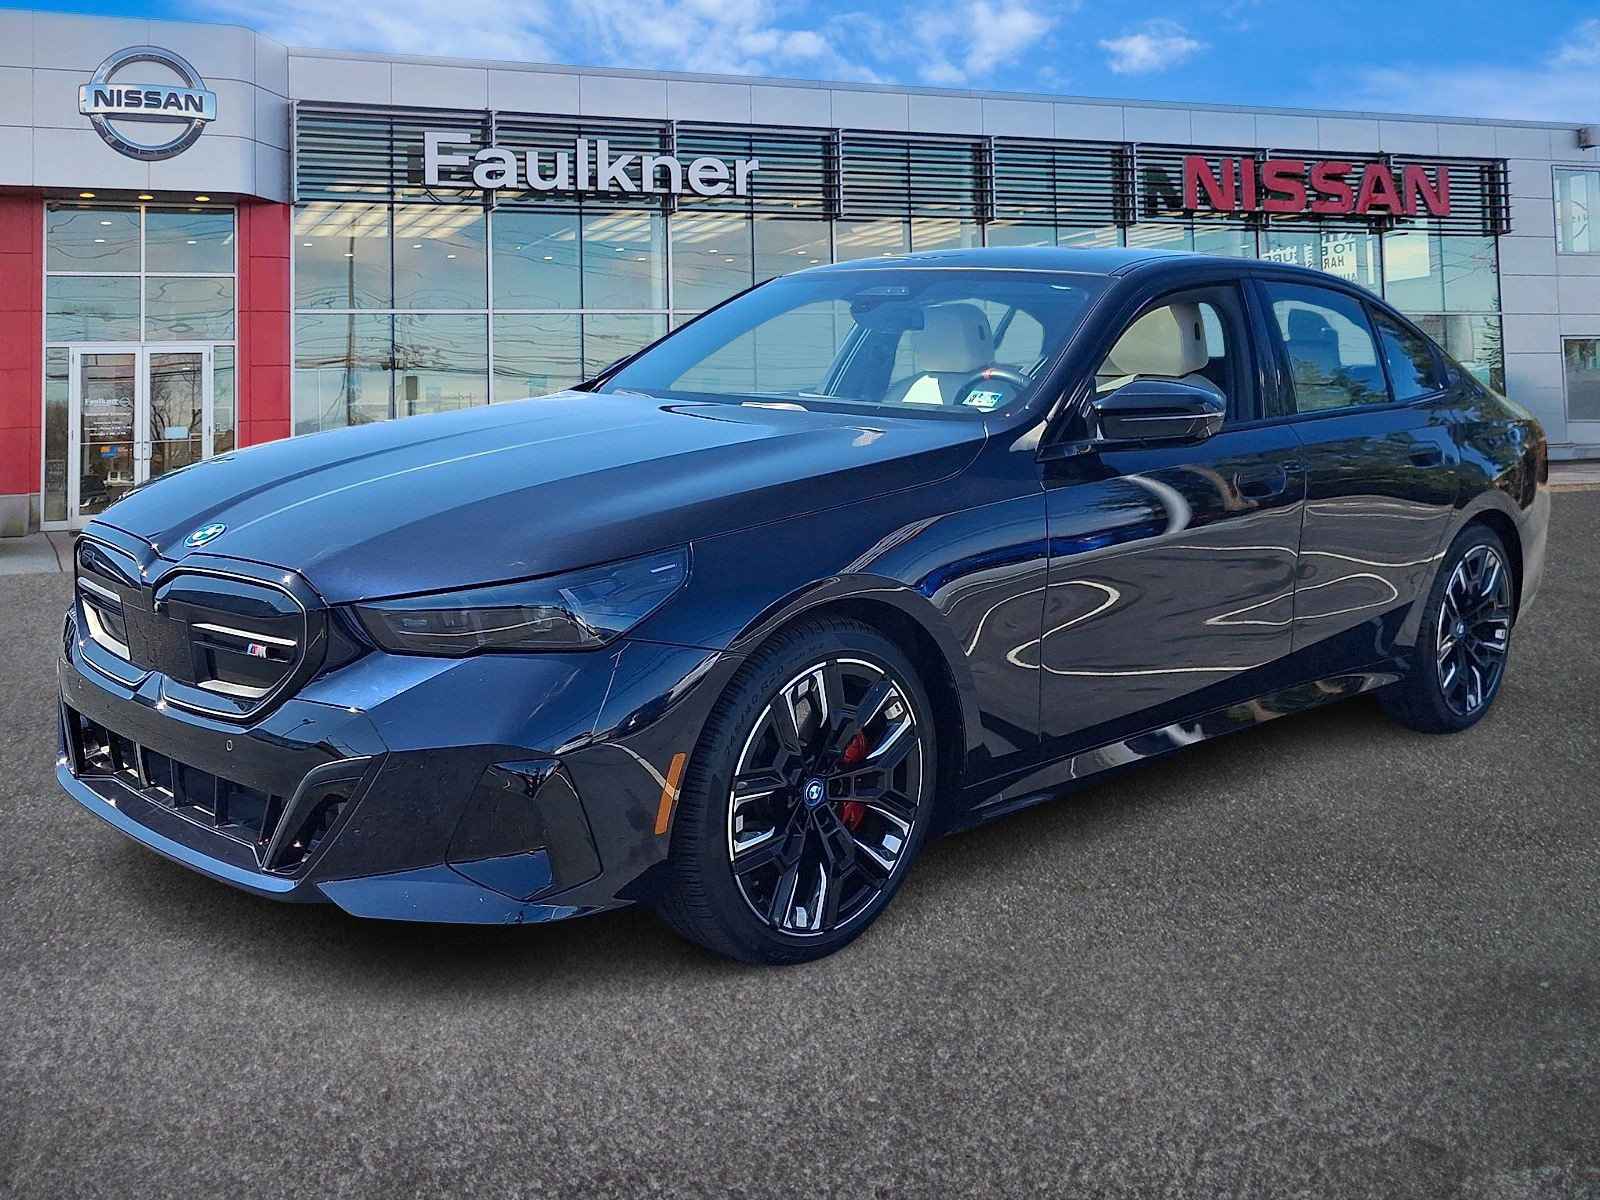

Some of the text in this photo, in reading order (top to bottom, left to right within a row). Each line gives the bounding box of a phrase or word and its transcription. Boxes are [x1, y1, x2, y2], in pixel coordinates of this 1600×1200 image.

[94, 89, 203, 113] NISSAN
[423, 131, 759, 196] Faulkner
[1184, 155, 1451, 217] NISSAN
